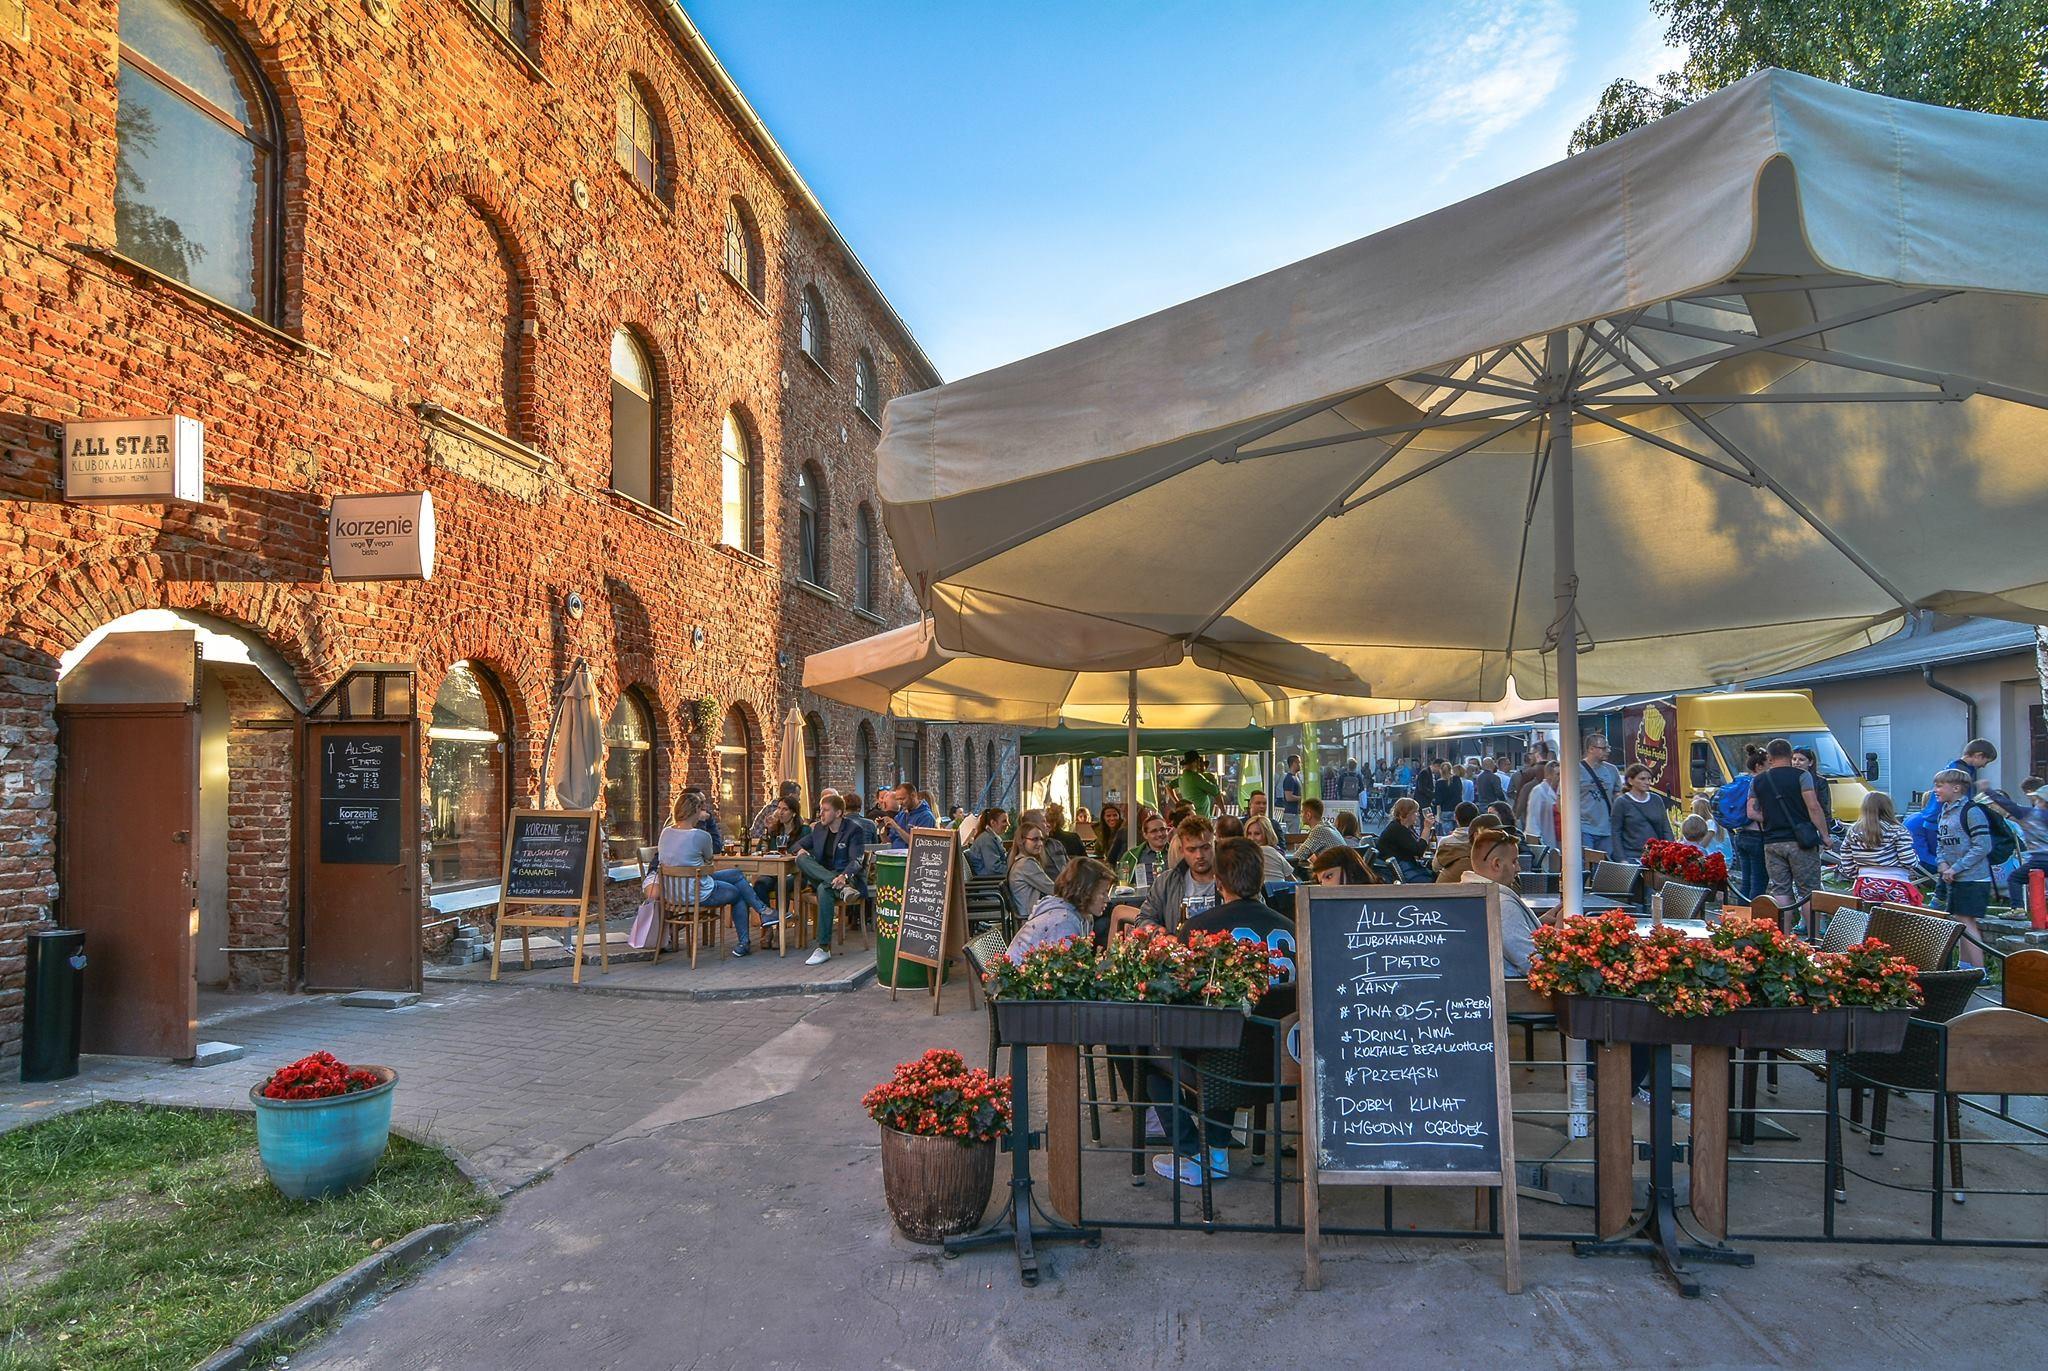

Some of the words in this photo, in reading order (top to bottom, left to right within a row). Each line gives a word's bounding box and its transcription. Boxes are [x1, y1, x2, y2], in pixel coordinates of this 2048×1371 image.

[71, 438, 109, 457] ALL
[116, 434, 170, 455] STAR
[72, 457, 170, 471] KLUBOKAWIARNIA
[335, 515, 412, 536] korzenie
[374, 540, 394, 548] vegan
[345, 742, 362, 755] ALL
[339, 807, 379, 820] korzenie
[525, 822, 562, 836] KORZENIE
[1356, 904, 1393, 932] ALL
[1395, 905, 1448, 928] STAR
[1353, 1003, 1392, 1021] PIWA
[1395, 1003, 1415, 1019] OD
[1418, 1026, 1455, 1040] WINA
[1335, 1096, 1393, 1116] DOBRY
[1409, 1095, 1466, 1112] KLIMAT
[1343, 1119, 1413, 1136] WYGODNY
